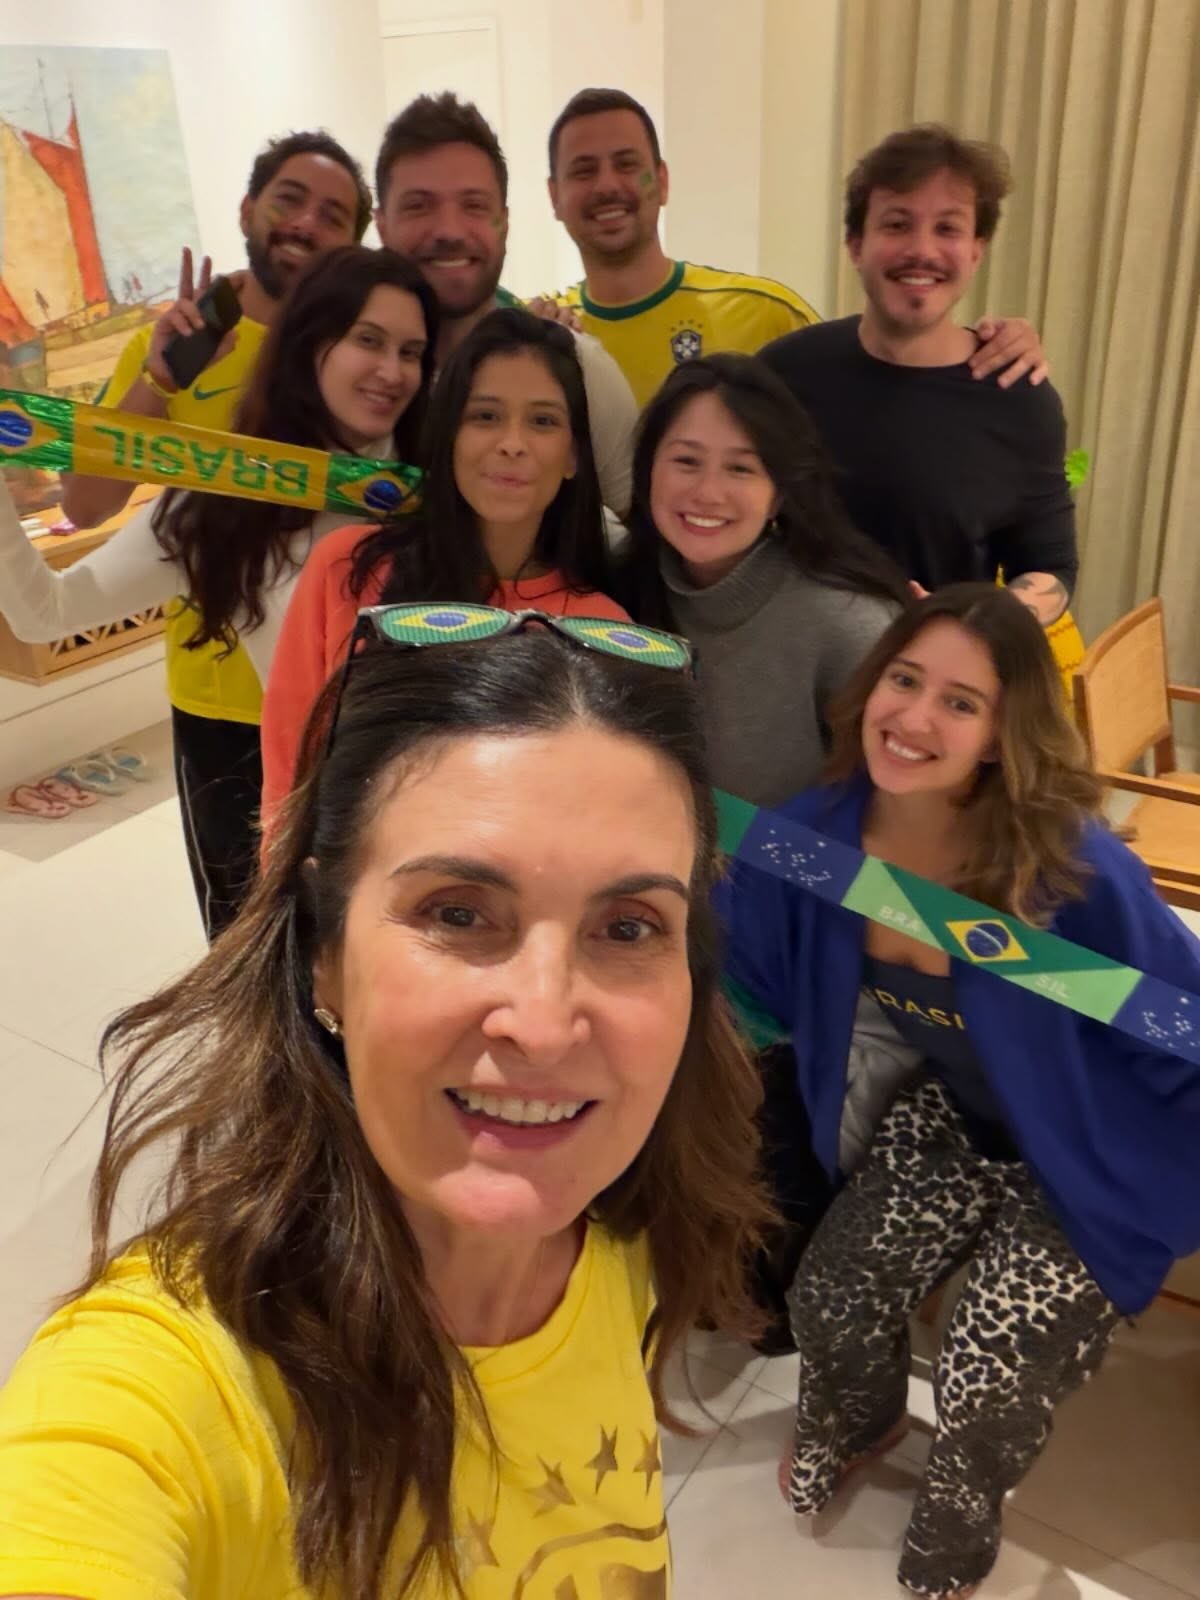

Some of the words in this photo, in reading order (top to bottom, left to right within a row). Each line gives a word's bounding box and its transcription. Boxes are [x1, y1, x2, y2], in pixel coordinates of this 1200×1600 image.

[94, 425, 309, 497] BRASIL
[879, 905, 921, 931] BRA
[1035, 975, 1070, 999] SIL
